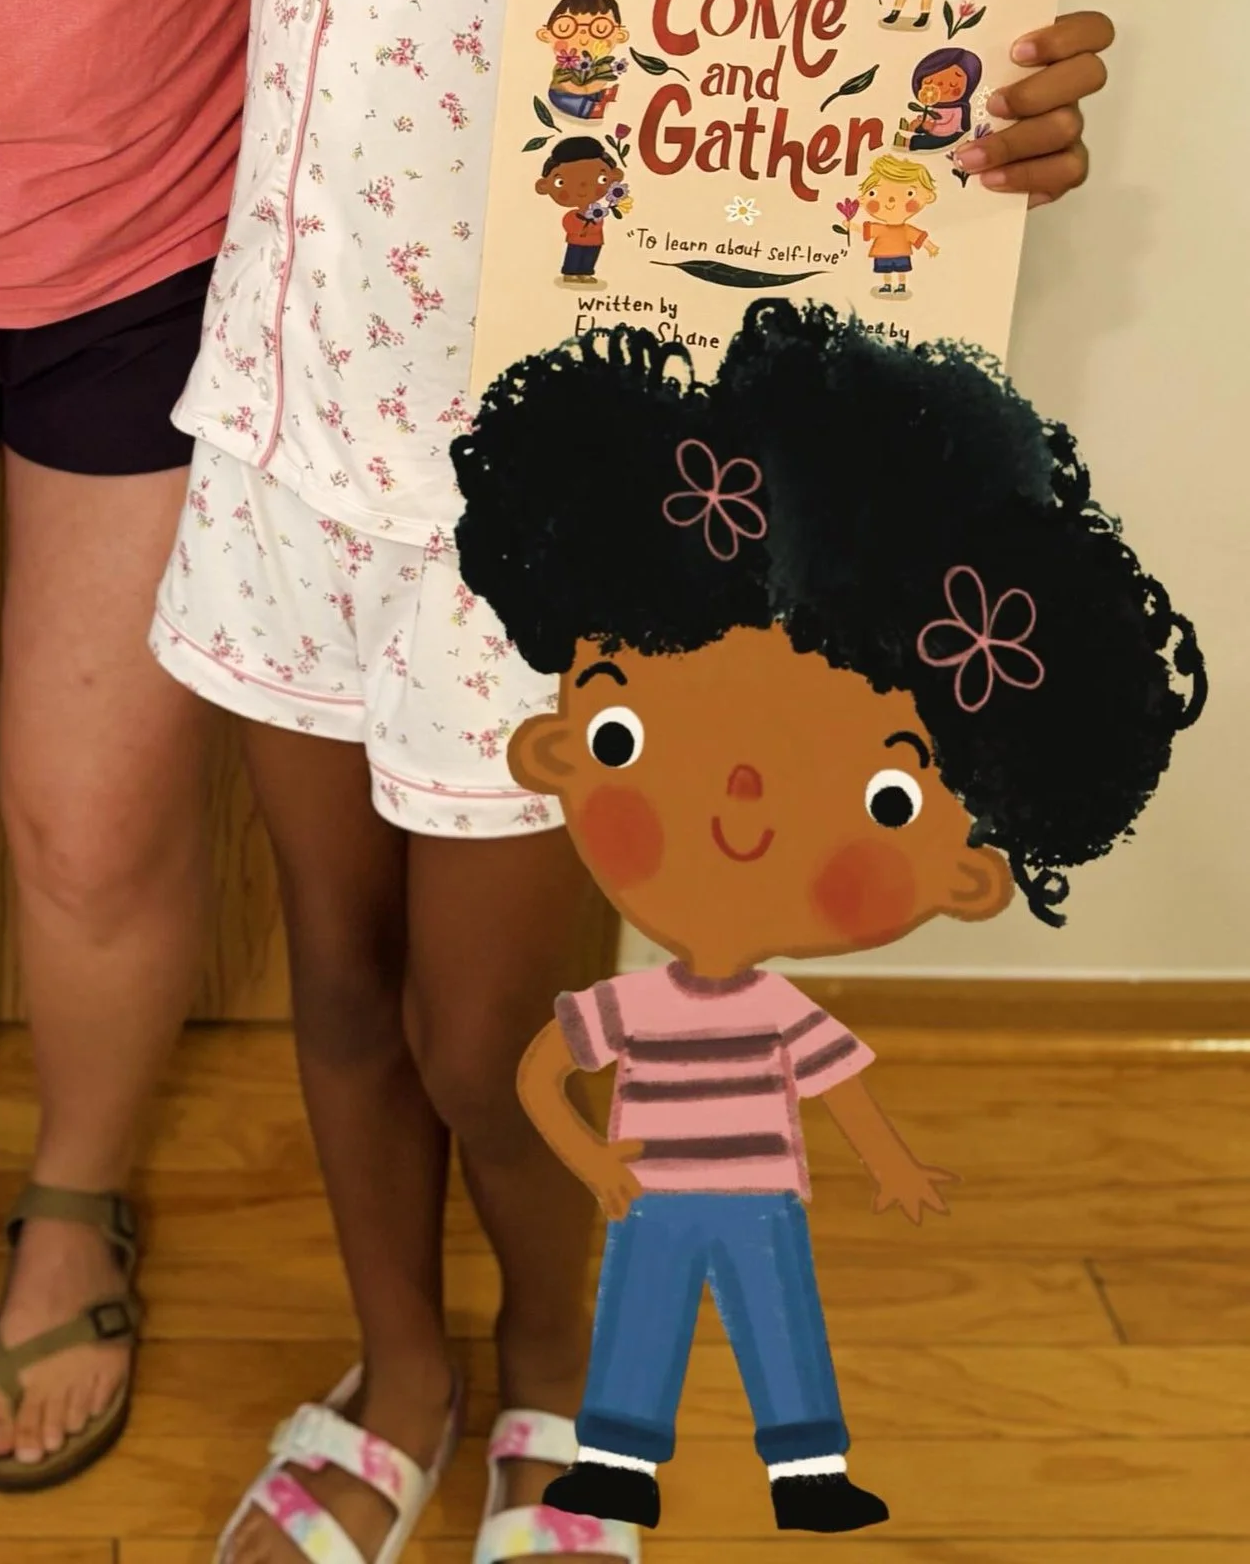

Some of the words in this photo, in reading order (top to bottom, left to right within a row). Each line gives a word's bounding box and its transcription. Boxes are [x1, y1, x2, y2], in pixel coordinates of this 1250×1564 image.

[699, 44, 786, 103] and
[638, 83, 884, 202] Gather
[665, 232, 707, 252] learn
[715, 238, 762, 258] about
[660, 296, 678, 319] by
[658, 321, 720, 349] Shane
